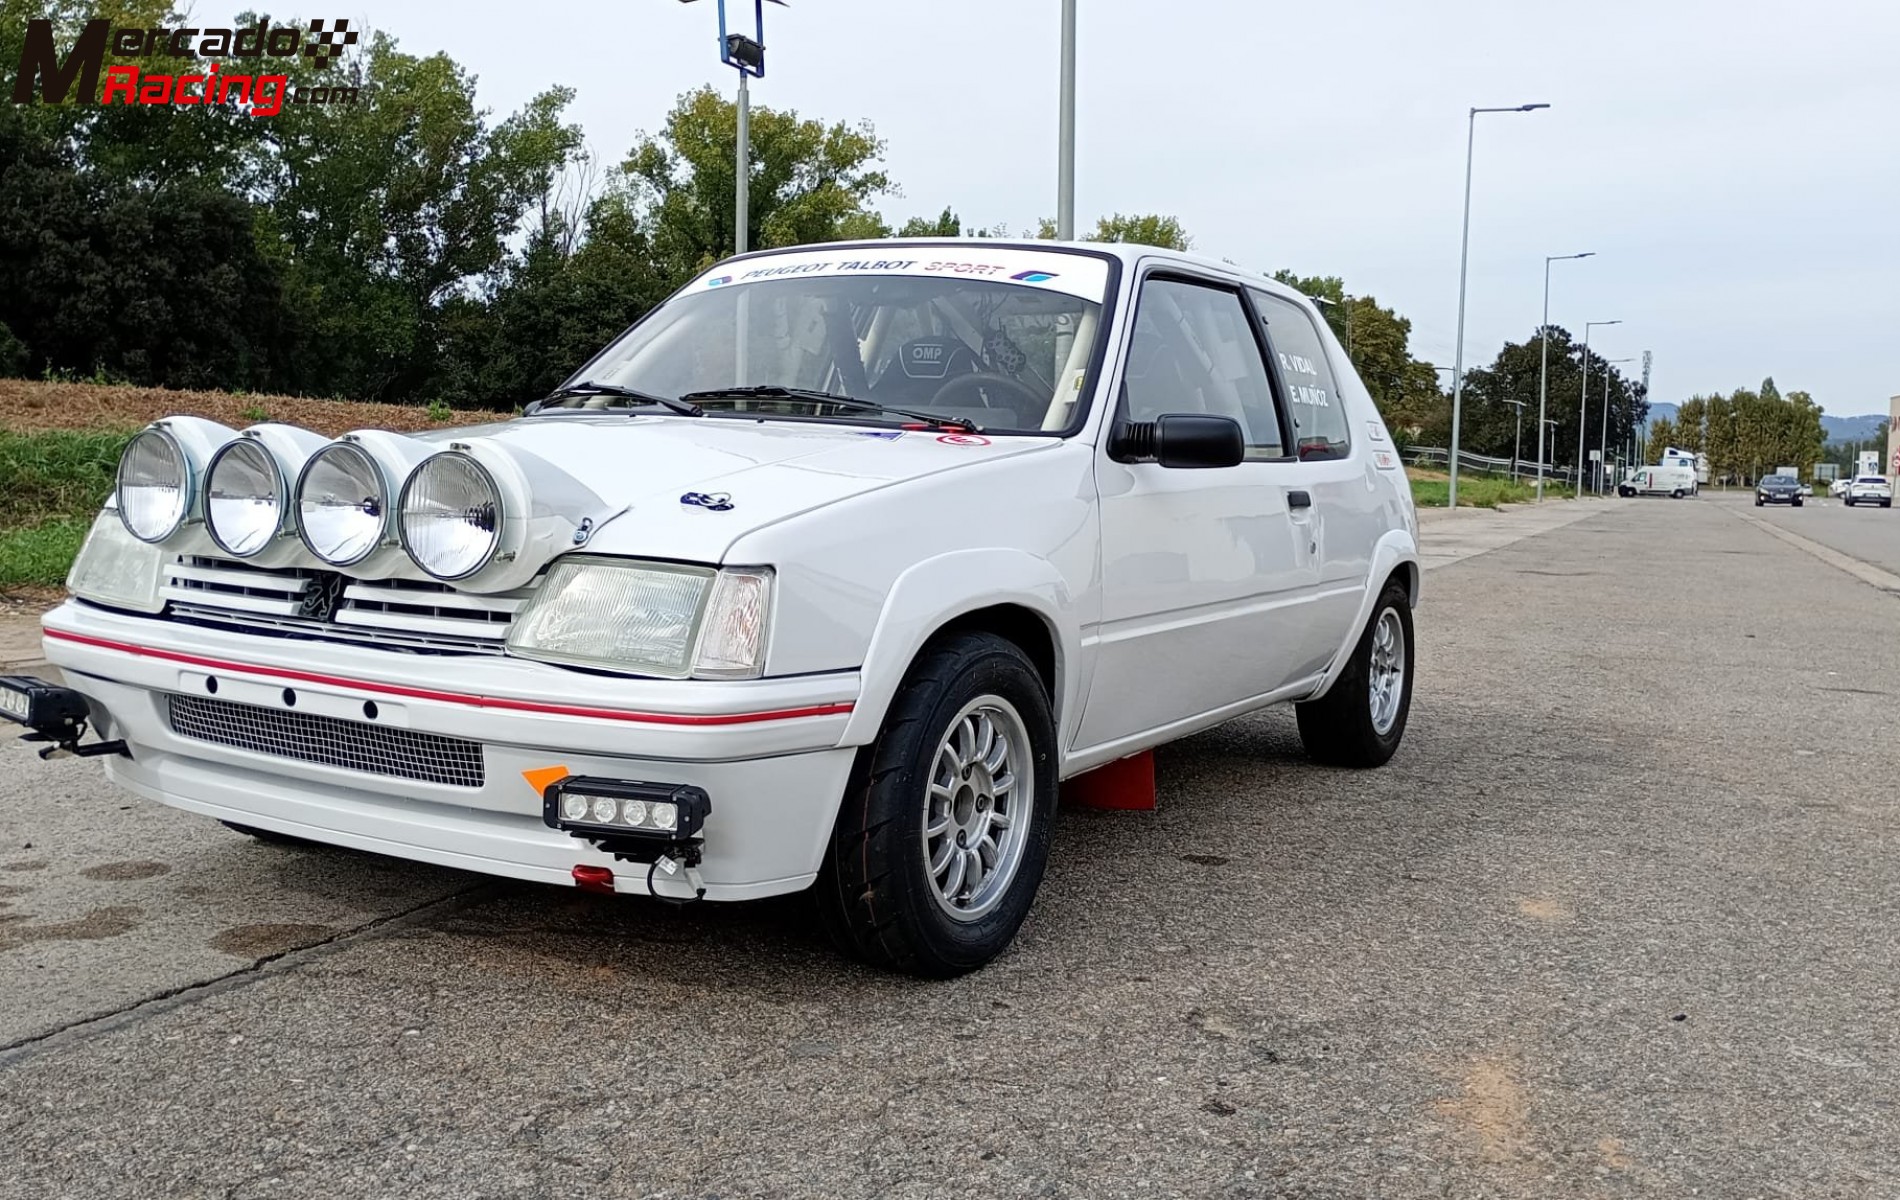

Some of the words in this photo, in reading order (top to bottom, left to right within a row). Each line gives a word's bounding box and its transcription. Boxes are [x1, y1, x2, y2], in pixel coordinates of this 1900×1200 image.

[740, 262, 834, 280] PEUGEOT
[837, 260, 917, 271] TALBOT
[924, 261, 1006, 275] SPORT
[912, 347, 942, 360] OMP
[1289, 353, 1318, 376] VIDAL
